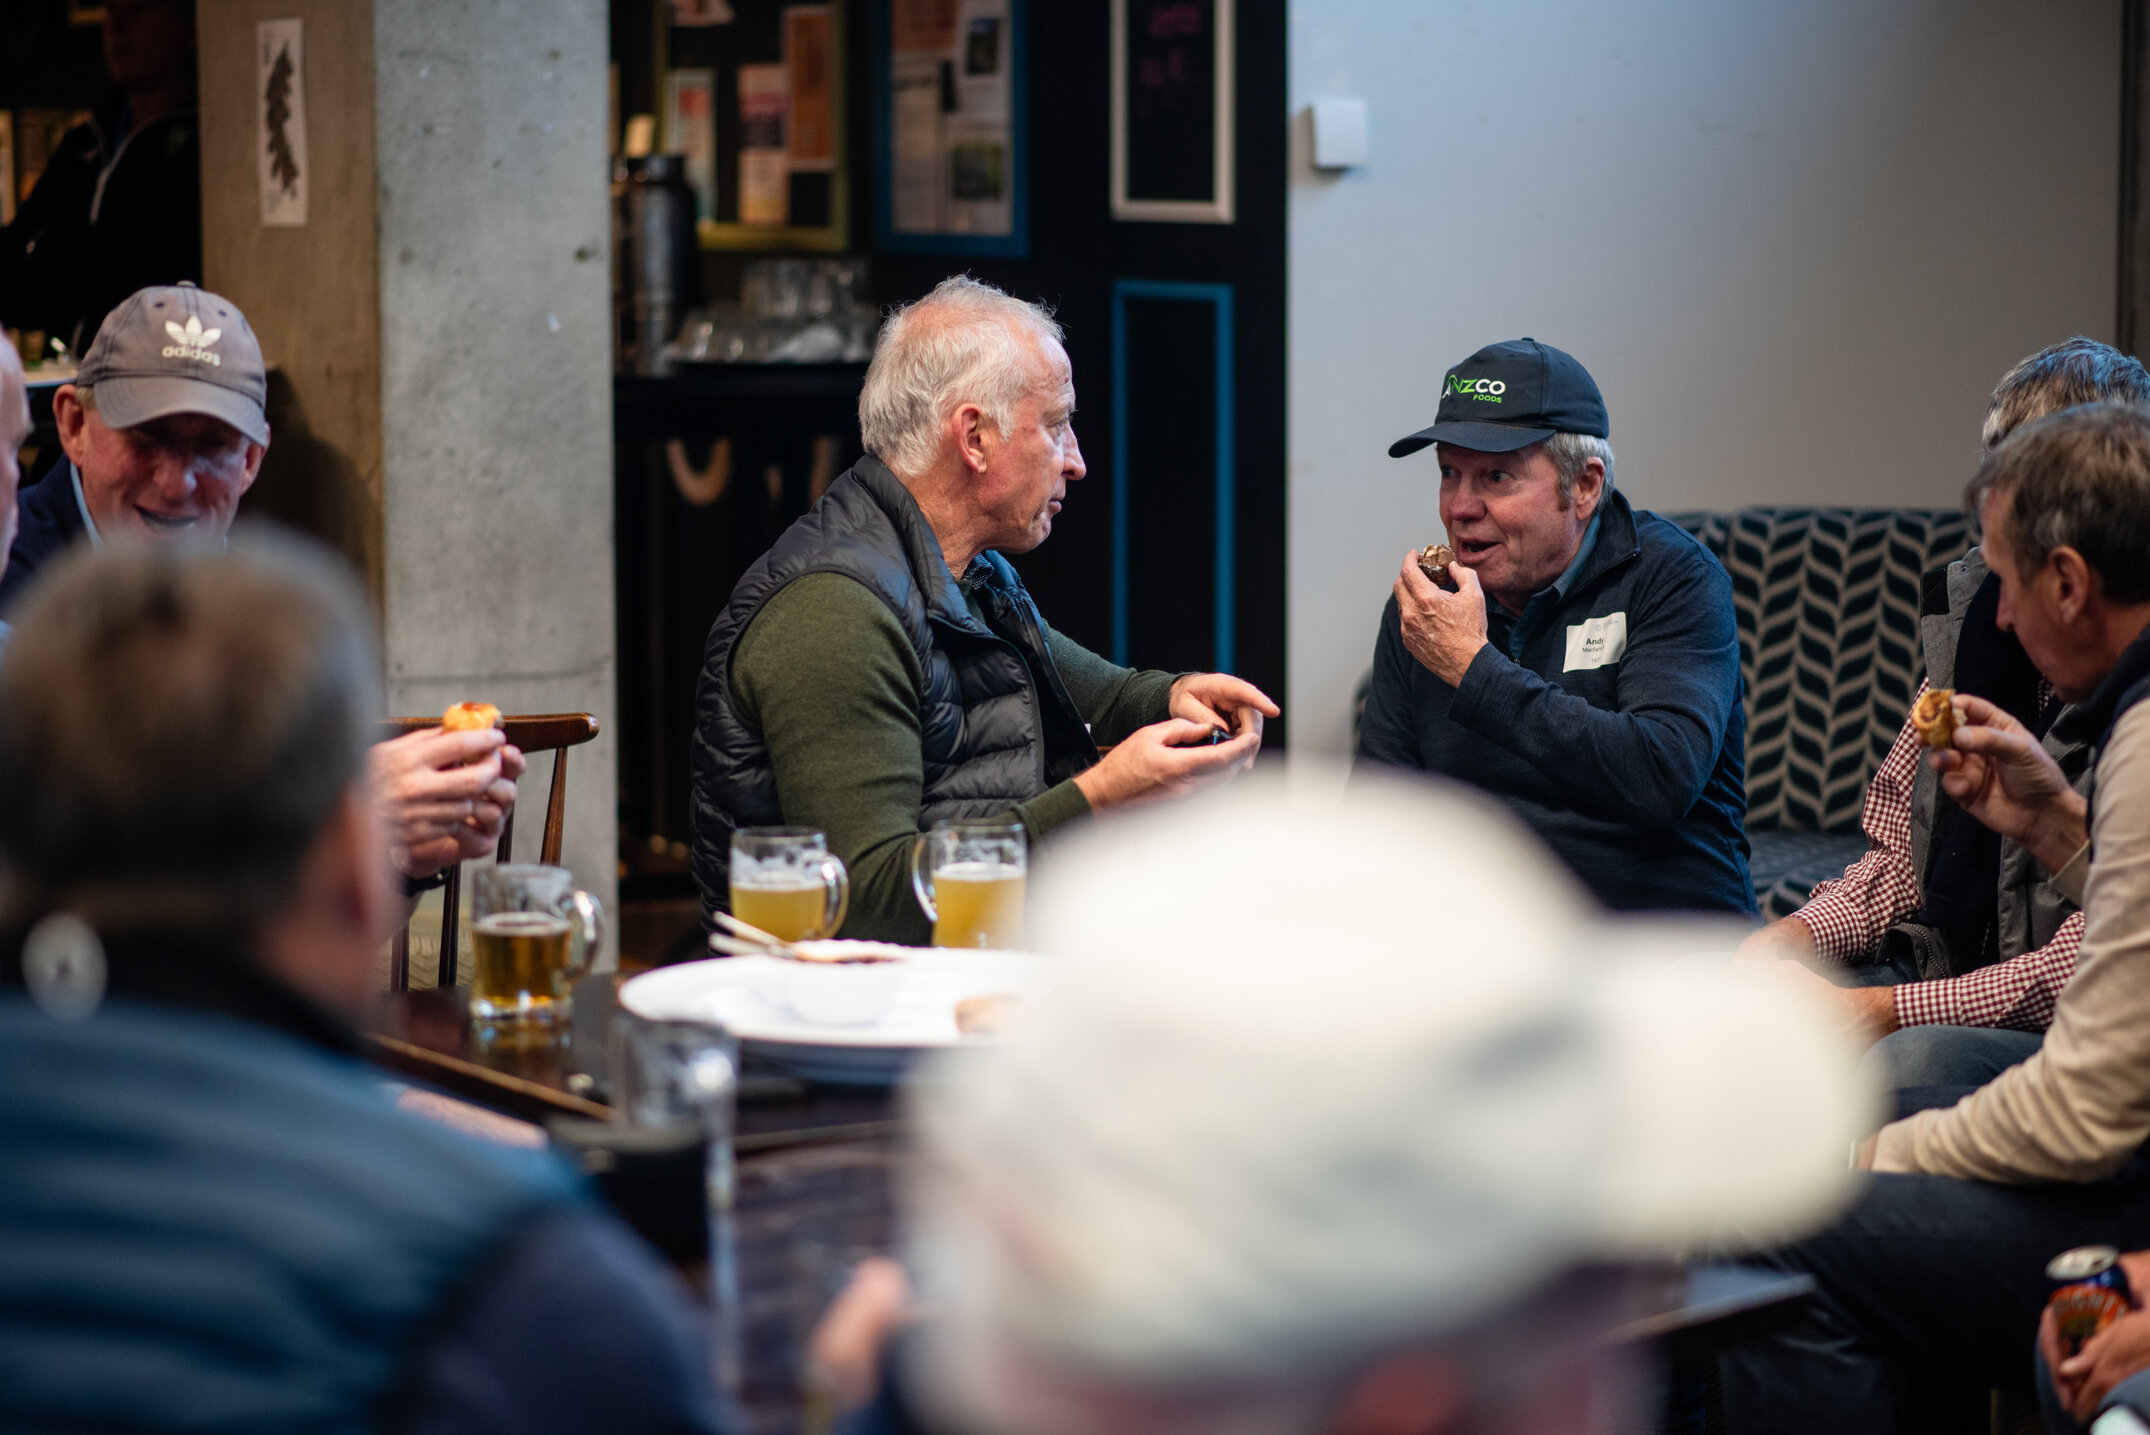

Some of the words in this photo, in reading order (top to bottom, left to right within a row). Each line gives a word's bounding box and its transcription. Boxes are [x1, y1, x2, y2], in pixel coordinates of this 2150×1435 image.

[162, 345, 221, 367] adidas
[1441, 374, 1506, 399] ANZCO
[1472, 393, 1503, 404] FOODS
